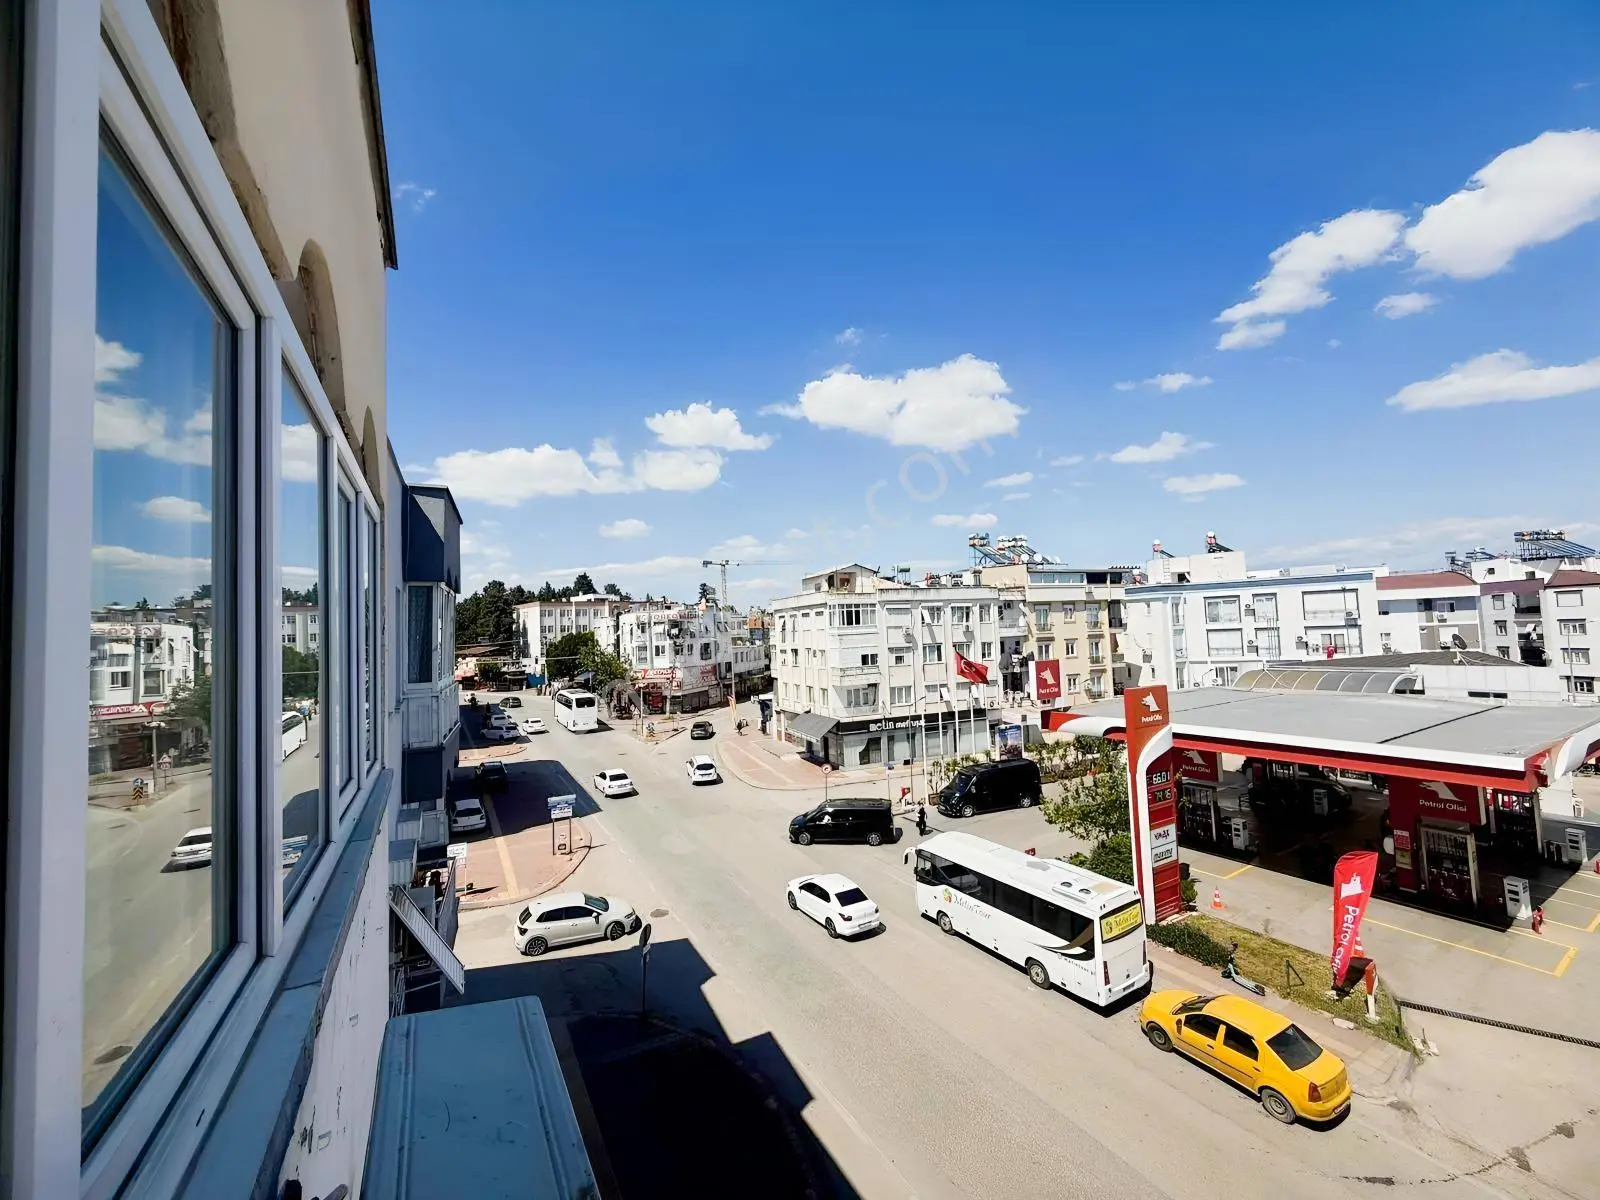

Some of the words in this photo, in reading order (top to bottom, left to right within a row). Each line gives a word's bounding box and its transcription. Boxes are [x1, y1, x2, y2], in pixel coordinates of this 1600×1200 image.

[1419, 799, 1444, 809] Petrol
[1445, 803, 1467, 812] Ofisi
[1339, 904, 1360, 945] Petrol
